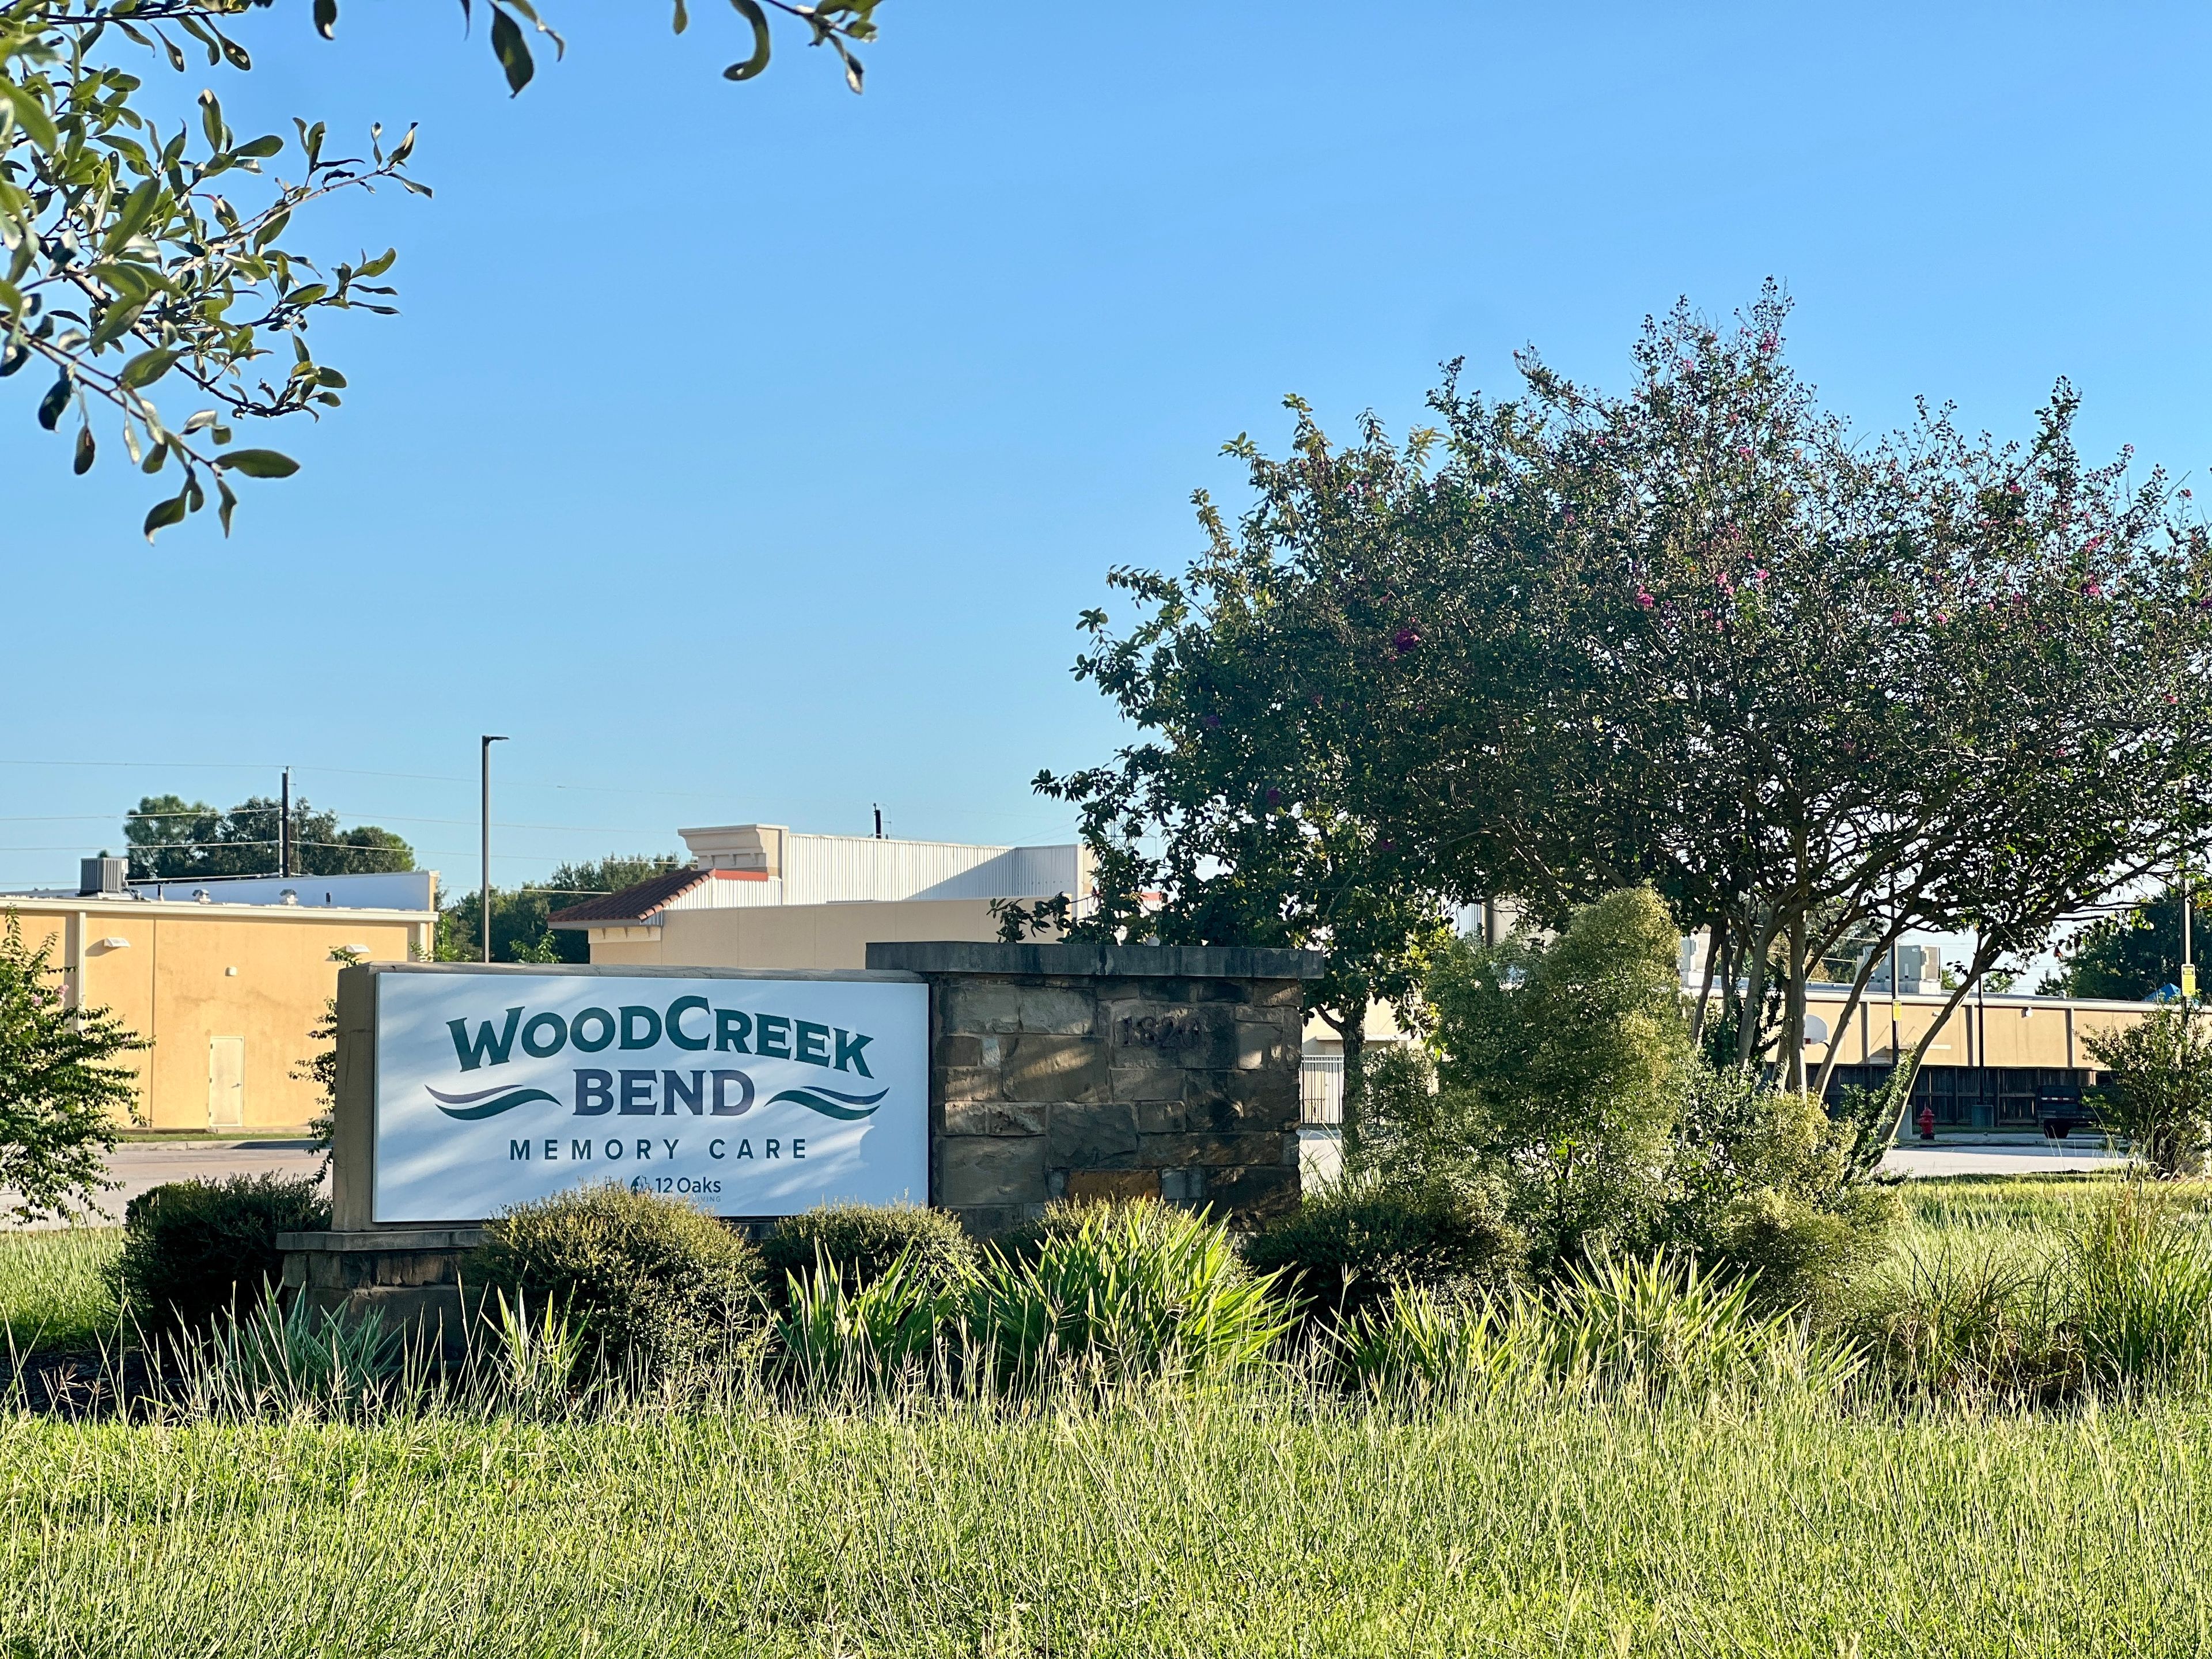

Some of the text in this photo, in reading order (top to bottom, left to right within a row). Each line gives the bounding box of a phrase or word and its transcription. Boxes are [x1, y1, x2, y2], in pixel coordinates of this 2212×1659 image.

[446, 995, 874, 1078] WOODCREEK
[572, 1069, 755, 1116] BEND
[510, 1139, 806, 1161] MEMORY CARE
[655, 1176, 721, 1193] 12 Oaks
